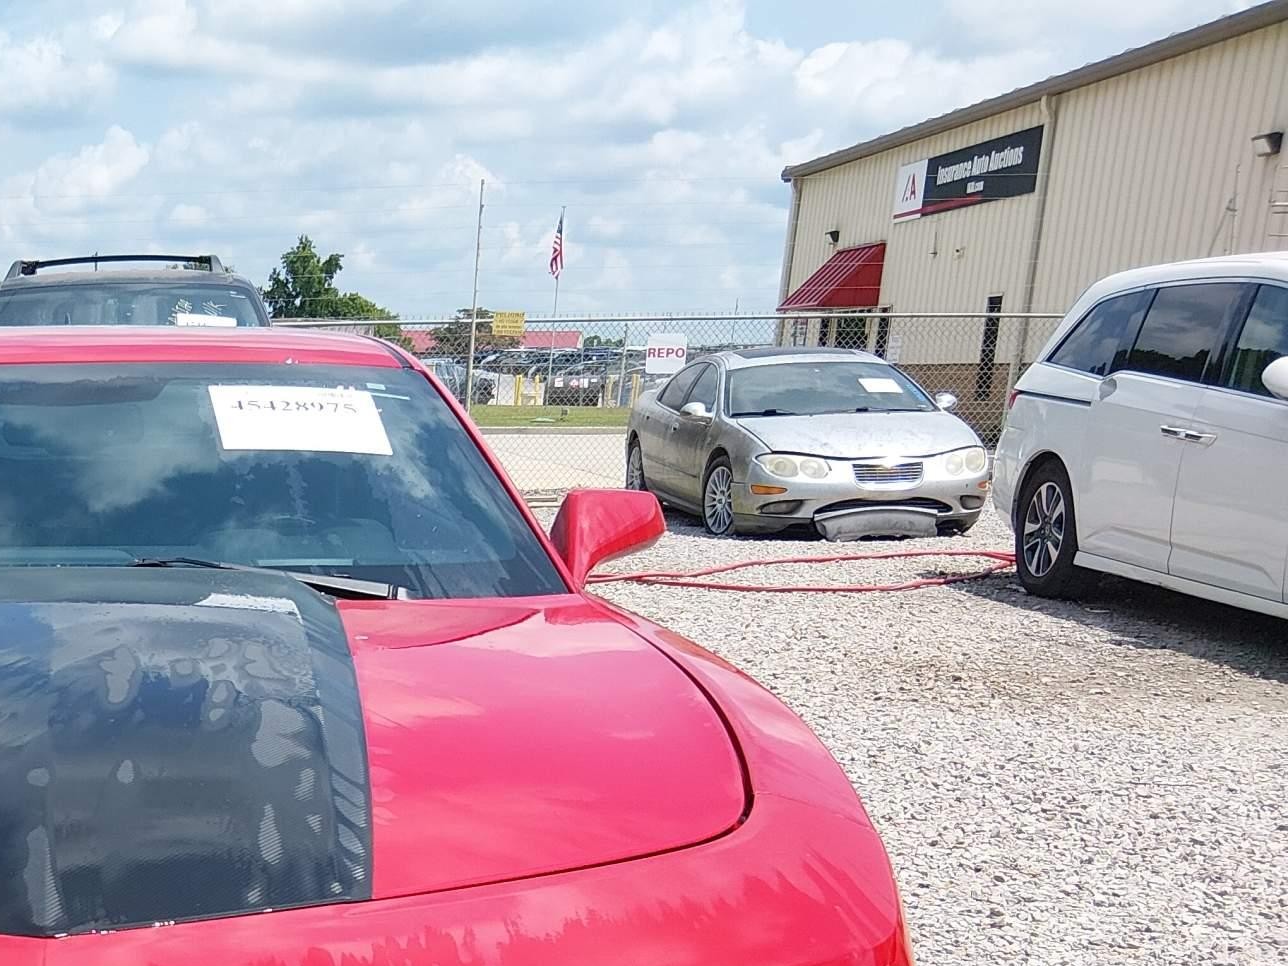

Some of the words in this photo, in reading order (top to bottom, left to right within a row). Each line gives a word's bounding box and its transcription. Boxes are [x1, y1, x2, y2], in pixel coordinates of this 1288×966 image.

[936, 159, 972, 186] Insurance
[971, 154, 989, 176] Auto
[988, 145, 1024, 173] Auctions
[647, 347, 686, 359] REPO
[231, 399, 358, 414] 45428975
